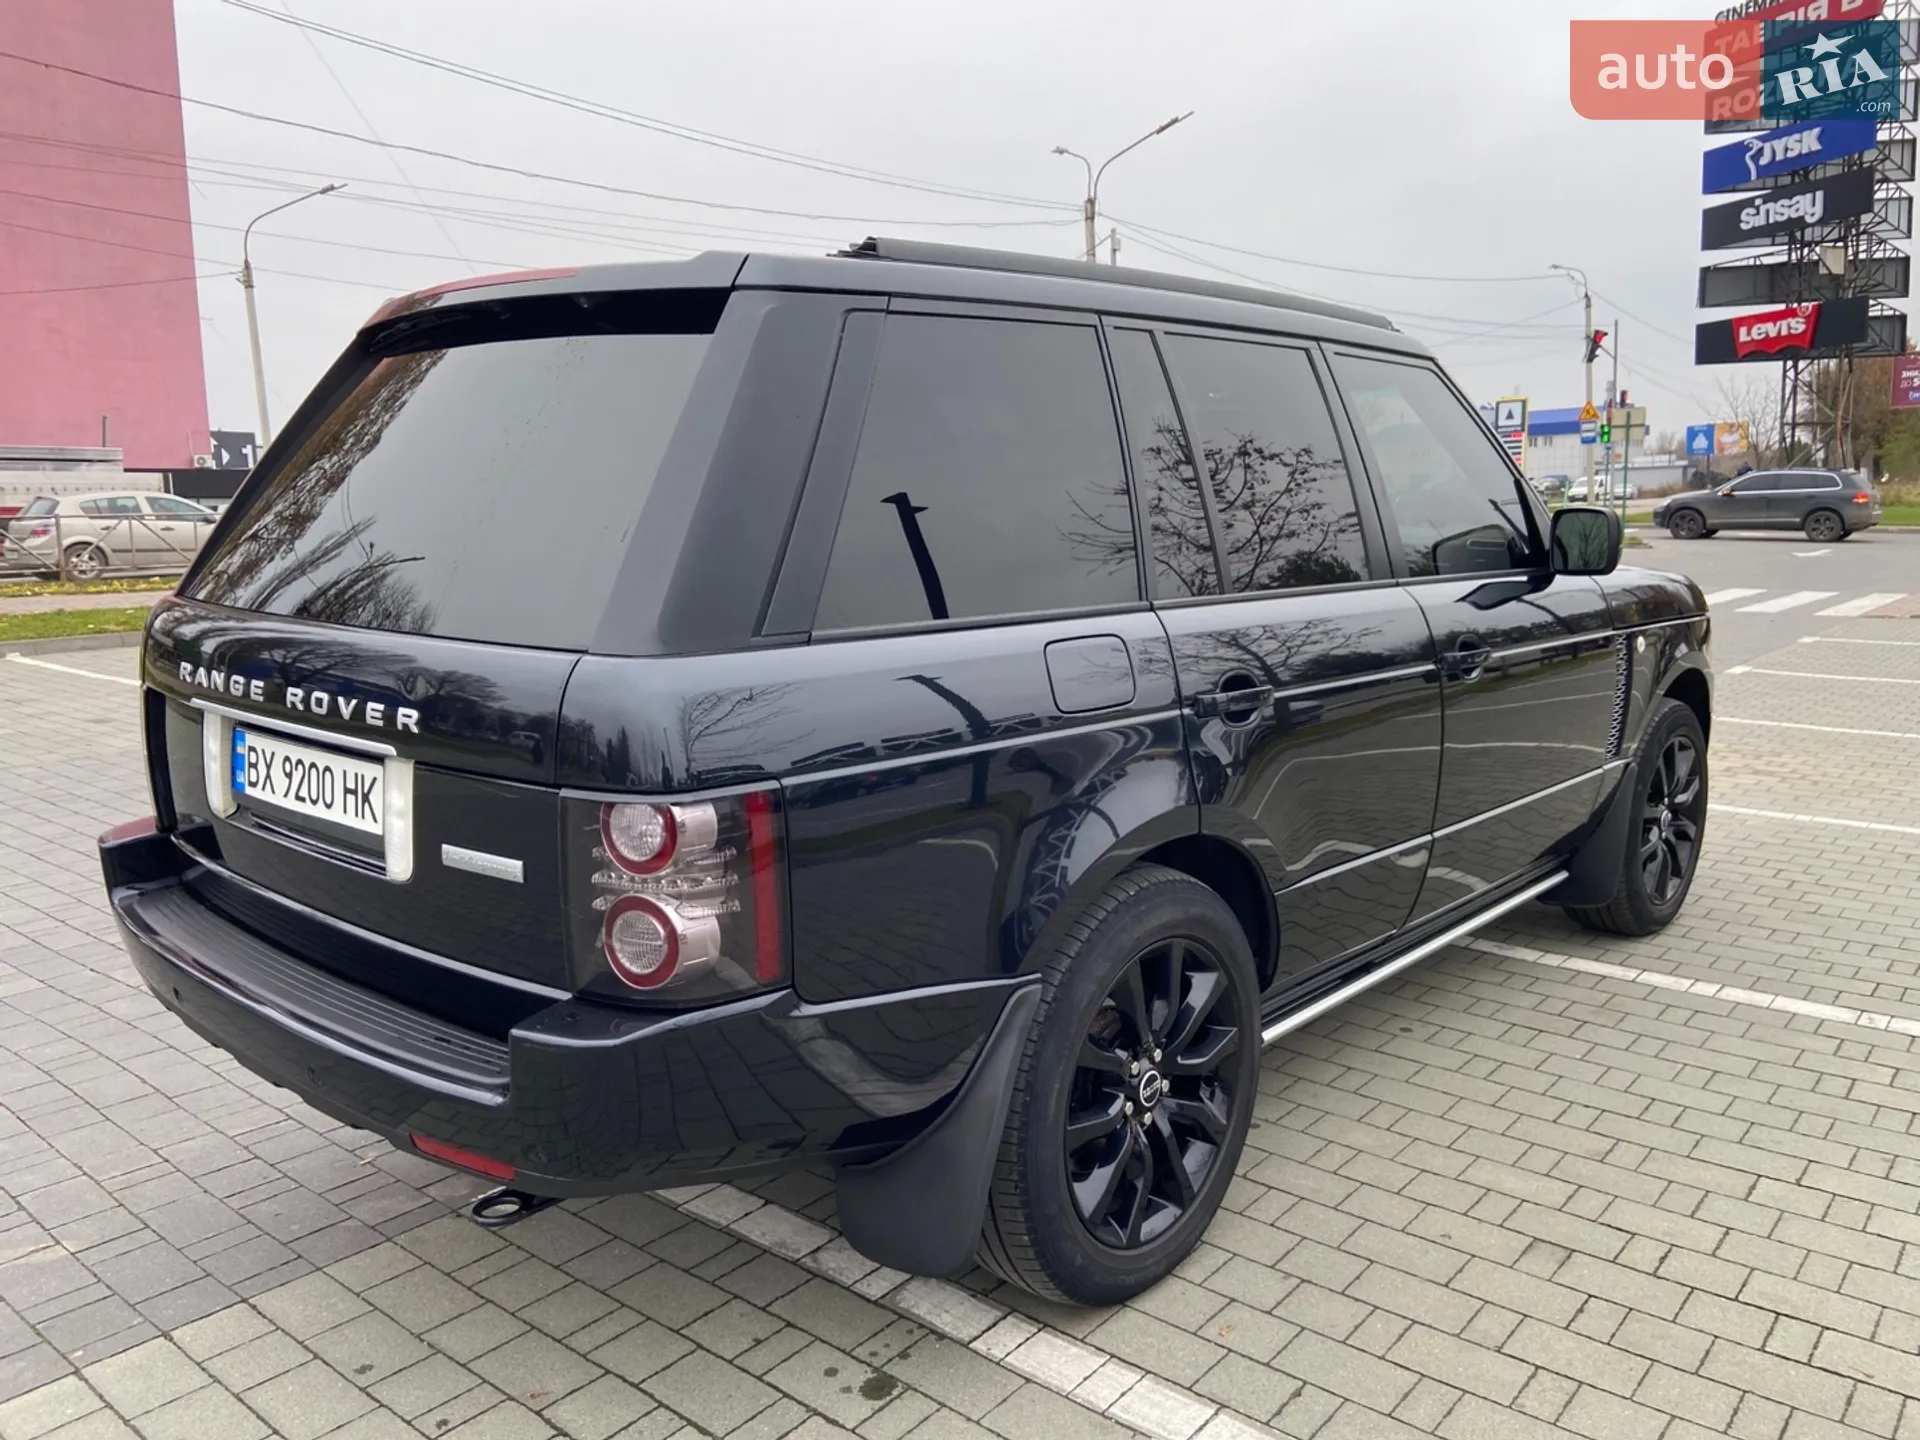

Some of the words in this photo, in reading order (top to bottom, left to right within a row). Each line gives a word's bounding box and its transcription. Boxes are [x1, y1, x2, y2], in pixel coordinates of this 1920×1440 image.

[1758, 126, 1823, 166] JYSK
[1740, 190, 1824, 230] sinsay
[179, 661, 264, 702] RANGE
[286, 687, 420, 734] ROVER
[247, 745, 275, 794] BX
[282, 755, 334, 810] 9200
[343, 769, 378, 823] HK
